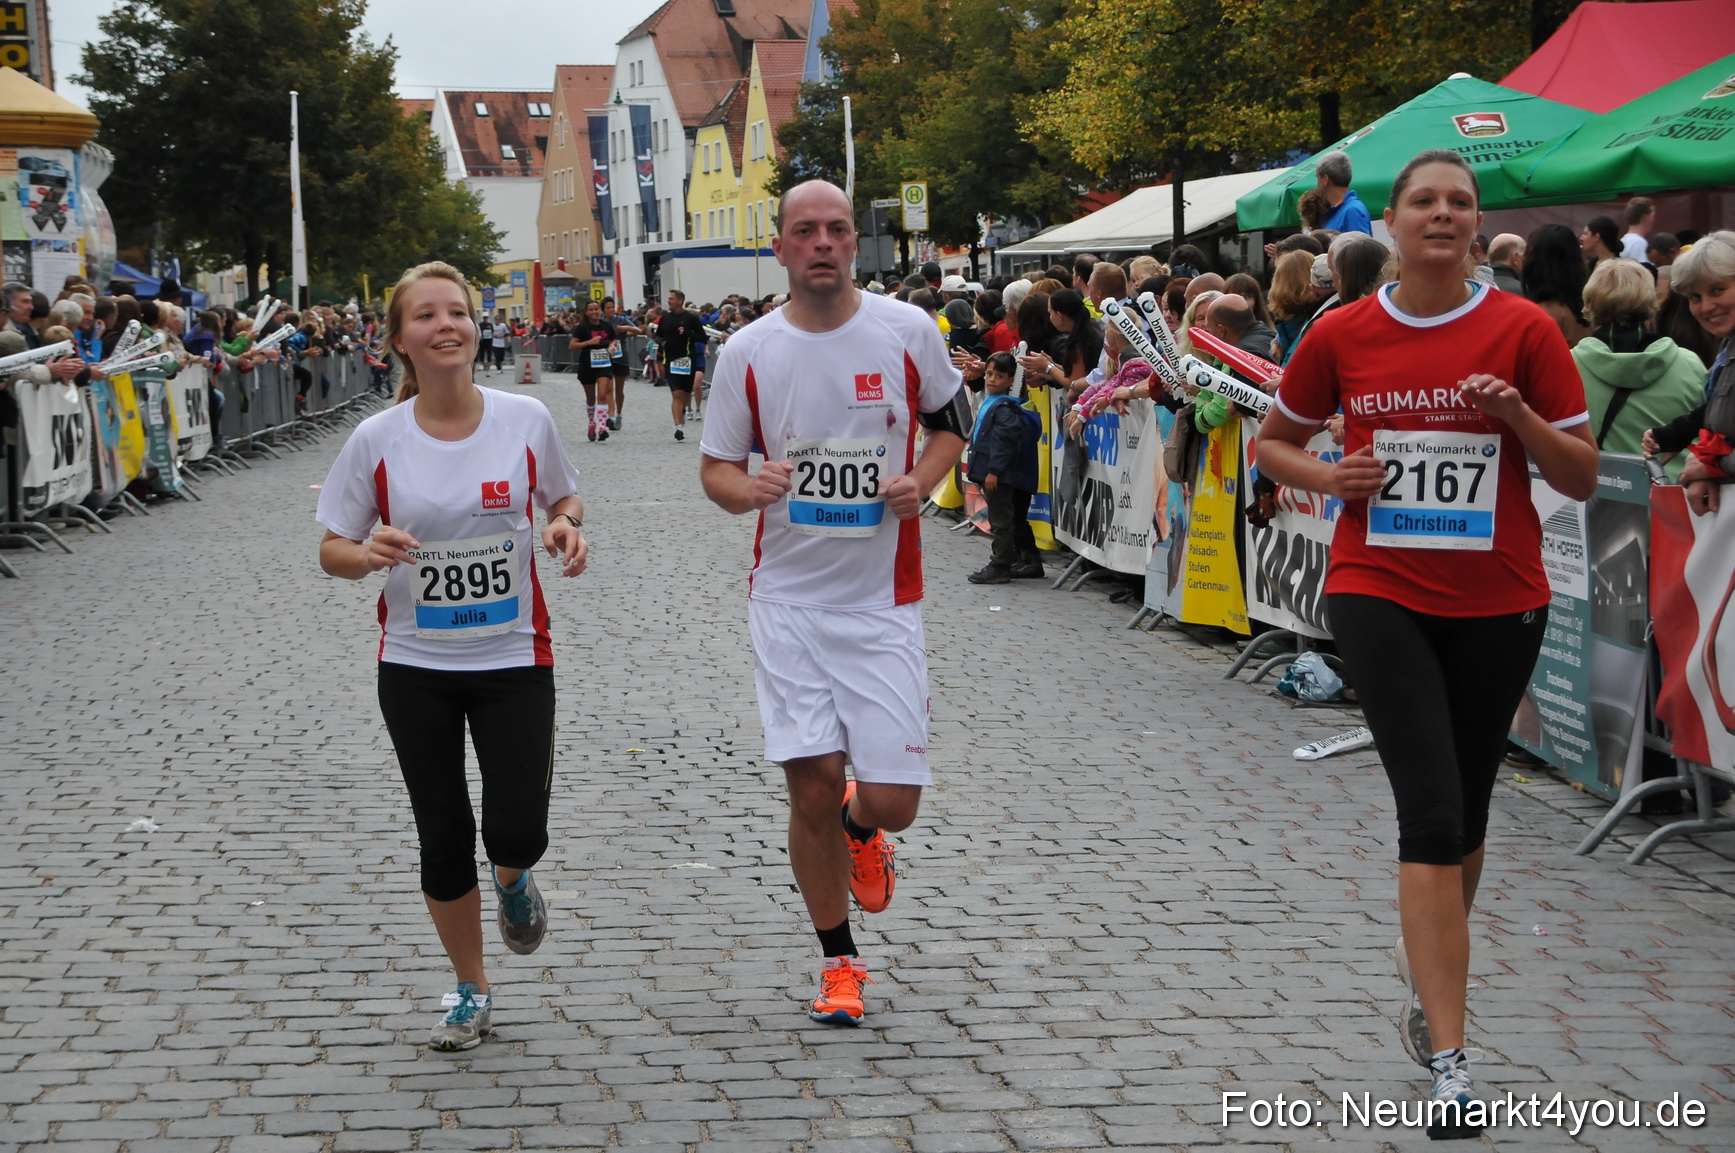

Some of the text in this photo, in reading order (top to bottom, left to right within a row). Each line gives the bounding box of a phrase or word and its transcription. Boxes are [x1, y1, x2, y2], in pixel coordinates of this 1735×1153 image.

[1119, 318, 1182, 391] BMW Laufsport
[858, 390, 881, 399] DKMS
[1216, 381, 1253, 405] BMW
[1351, 388, 1477, 416] NEUMARK
[1425, 414, 1482, 422] STARKE STADT
[786, 447, 873, 459] PARTL Neumarkt
[1375, 442, 1477, 456] PARTL Neumarkt
[797, 460, 880, 499] 2903
[1380, 459, 1487, 504] 2167
[484, 498, 509, 507] DKMS
[815, 507, 860, 523] Daniel
[1393, 513, 1467, 533] Christina
[408, 546, 500, 562] PARTL Neumarkt
[1557, 539, 1584, 561] HOFFER
[1188, 560, 1211, 573] Stufen
[420, 558, 511, 602] 2895
[451, 609, 487, 626] Julia
[905, 744, 926, 755] Reebo
